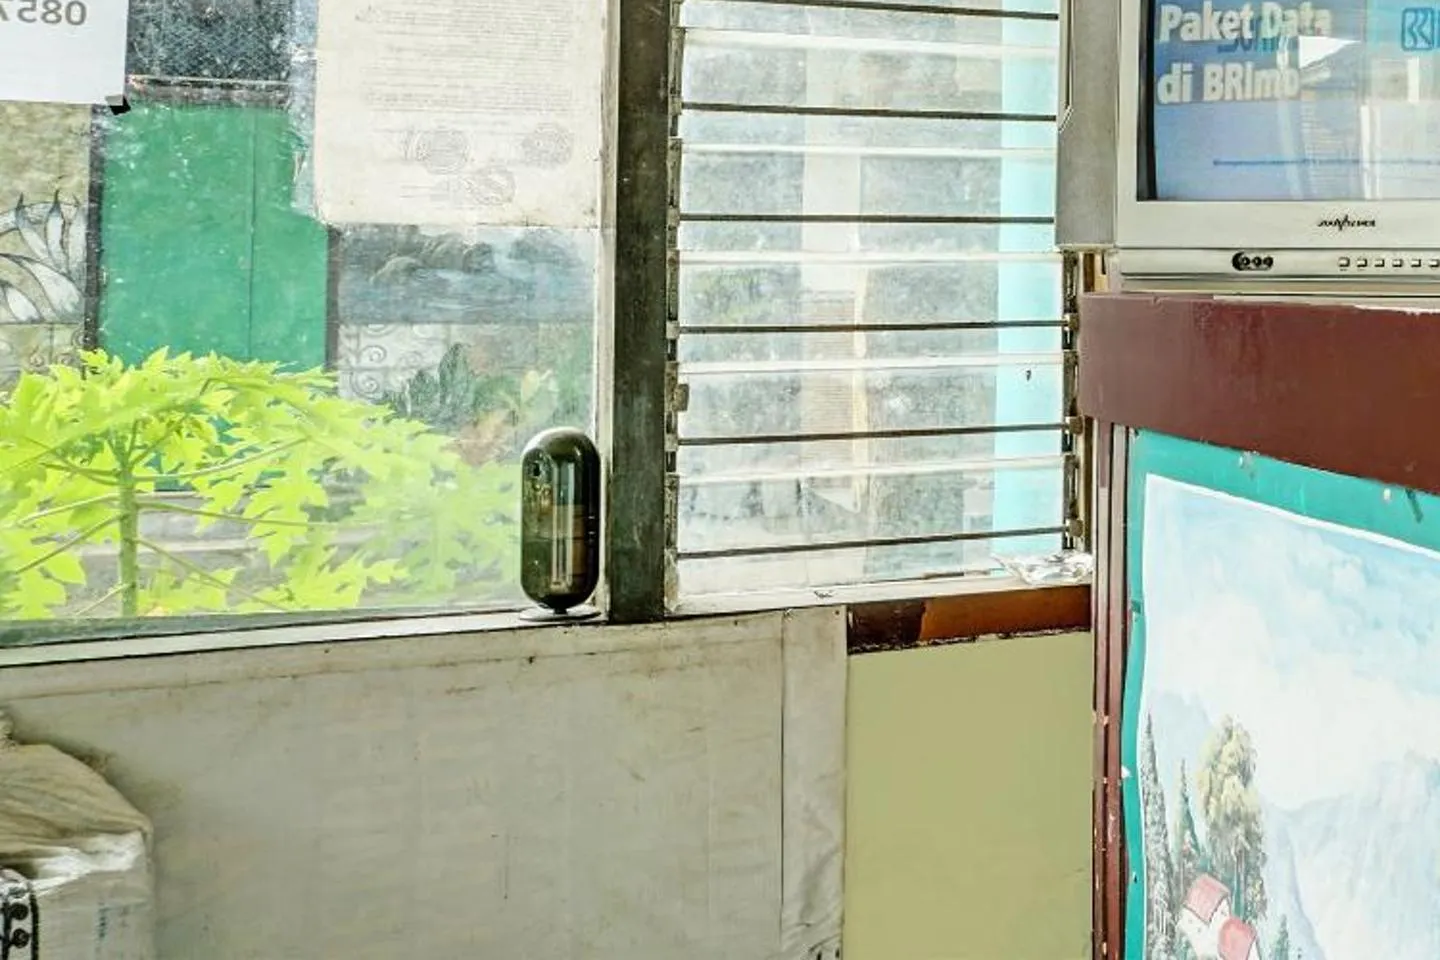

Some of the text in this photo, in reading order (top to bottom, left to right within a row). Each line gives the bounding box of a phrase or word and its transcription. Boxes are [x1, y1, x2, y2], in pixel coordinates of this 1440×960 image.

[1160, 0, 1255, 43] Paket
[1260, 0, 1332, 39] Data
[1157, 61, 1301, 104] di BRImo
